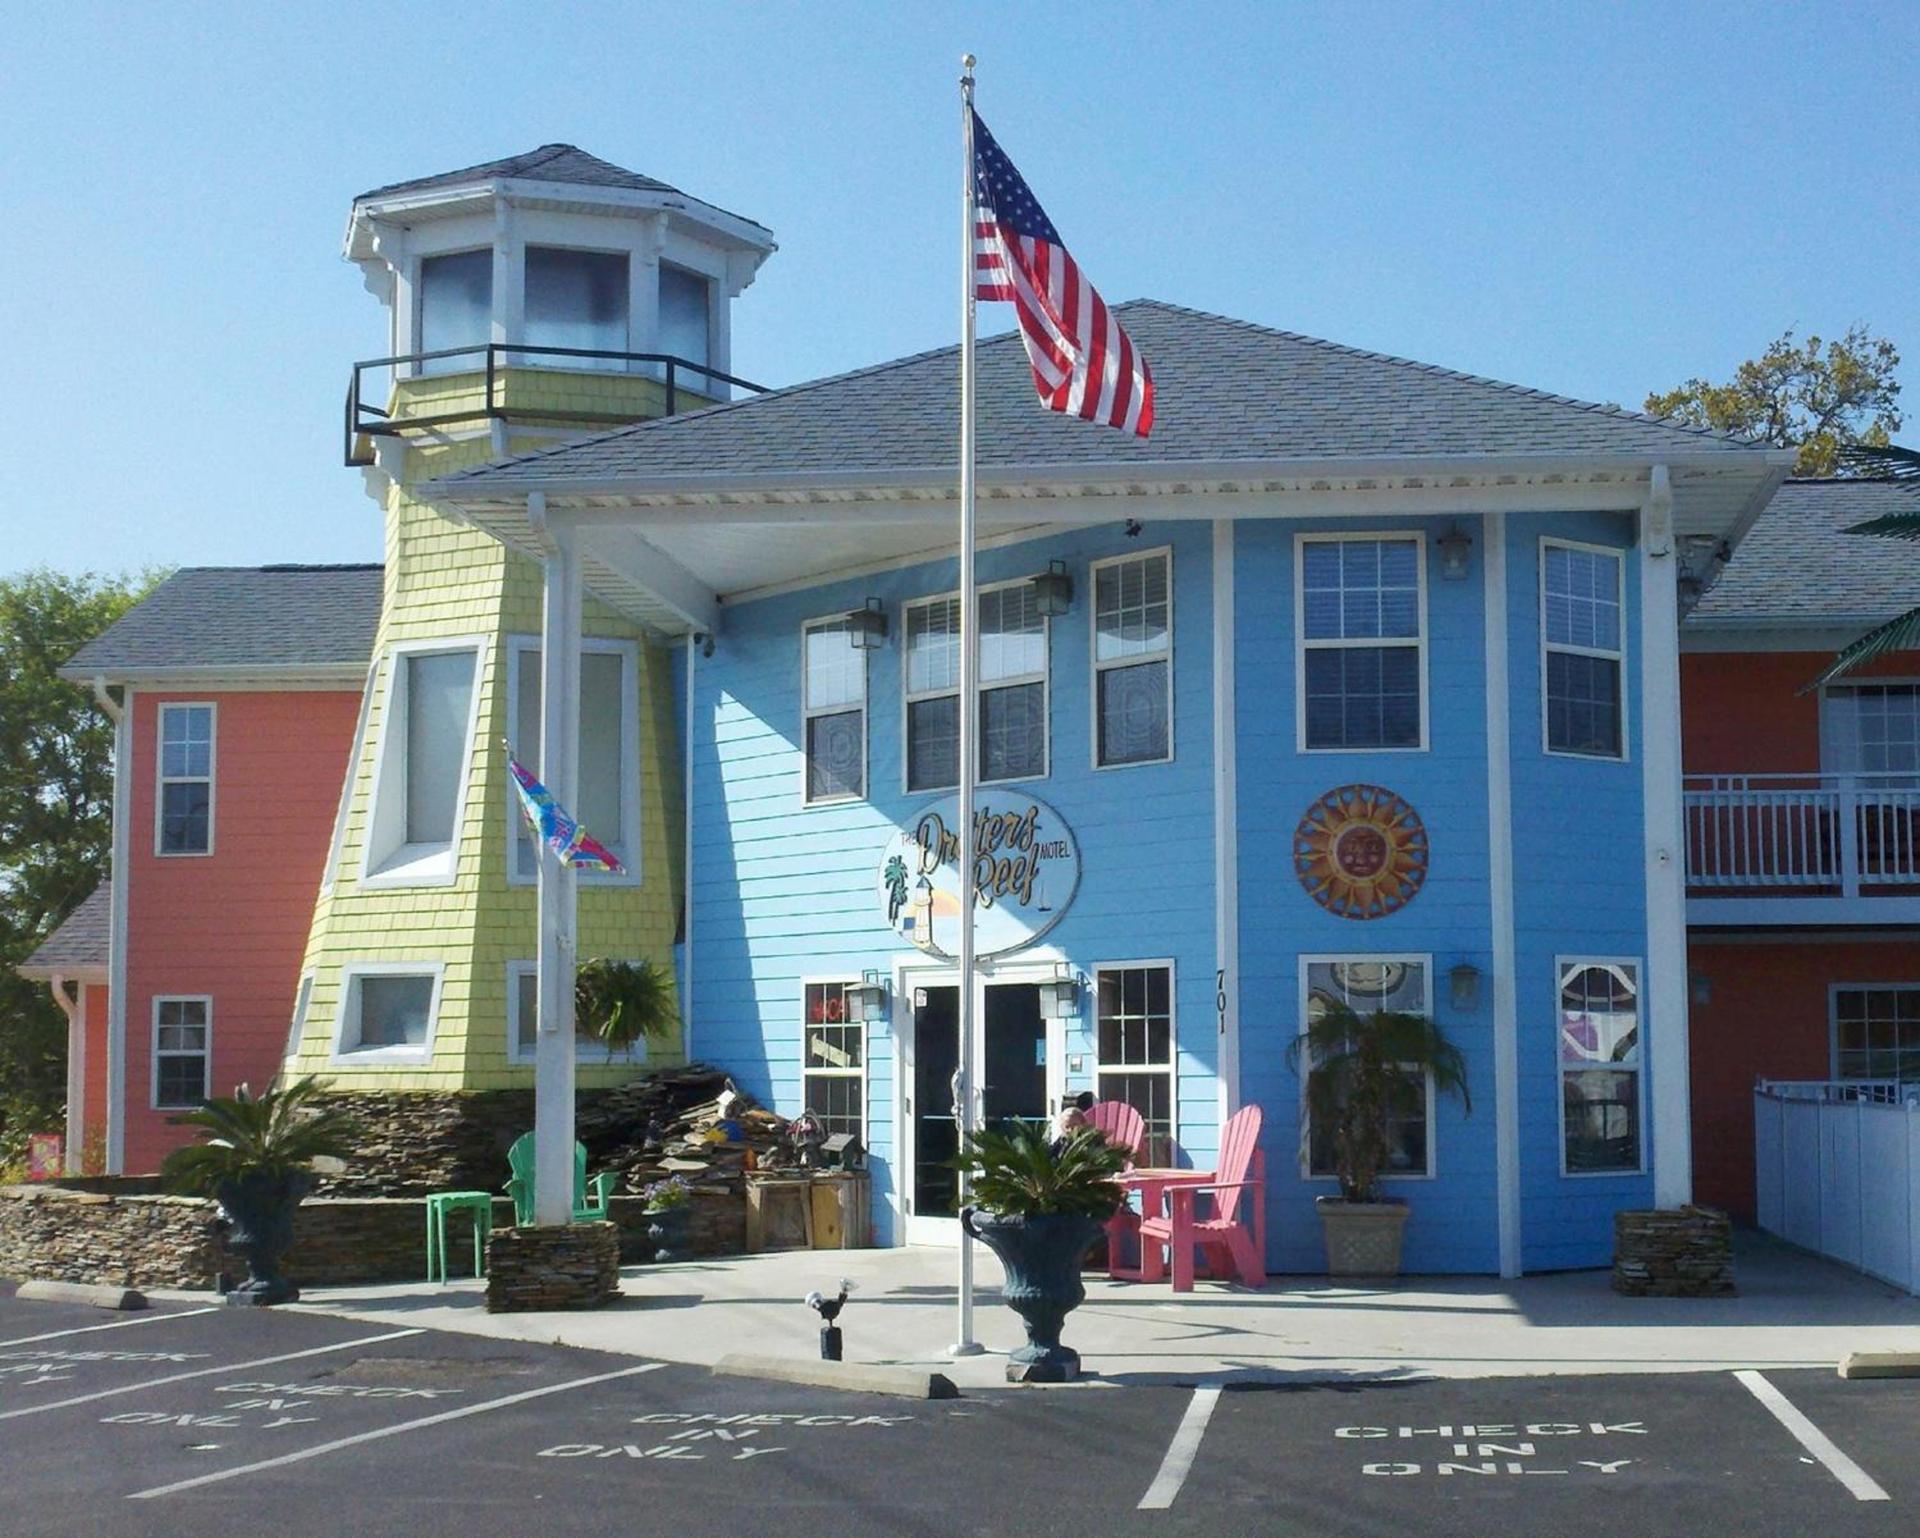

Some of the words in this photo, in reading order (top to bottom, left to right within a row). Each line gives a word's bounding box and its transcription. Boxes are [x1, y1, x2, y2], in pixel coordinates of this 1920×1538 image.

[916, 805, 1042, 875] Drters
[1040, 840, 1071, 860] MOTEL
[973, 843, 1039, 909] Reef
[1216, 969, 1226, 1034] 701
[214, 1383, 465, 1398] CHECK
[224, 1399, 312, 1410] IN
[99, 1412, 321, 1428] ONLY
[631, 1414, 915, 1426] CHECK
[666, 1429, 760, 1441] IN
[1333, 1422, 1649, 1438] CHECK
[536, 1445, 788, 1460] ONLY
[1453, 1443, 1536, 1456] IN
[1362, 1460, 1632, 1475] ONLY
